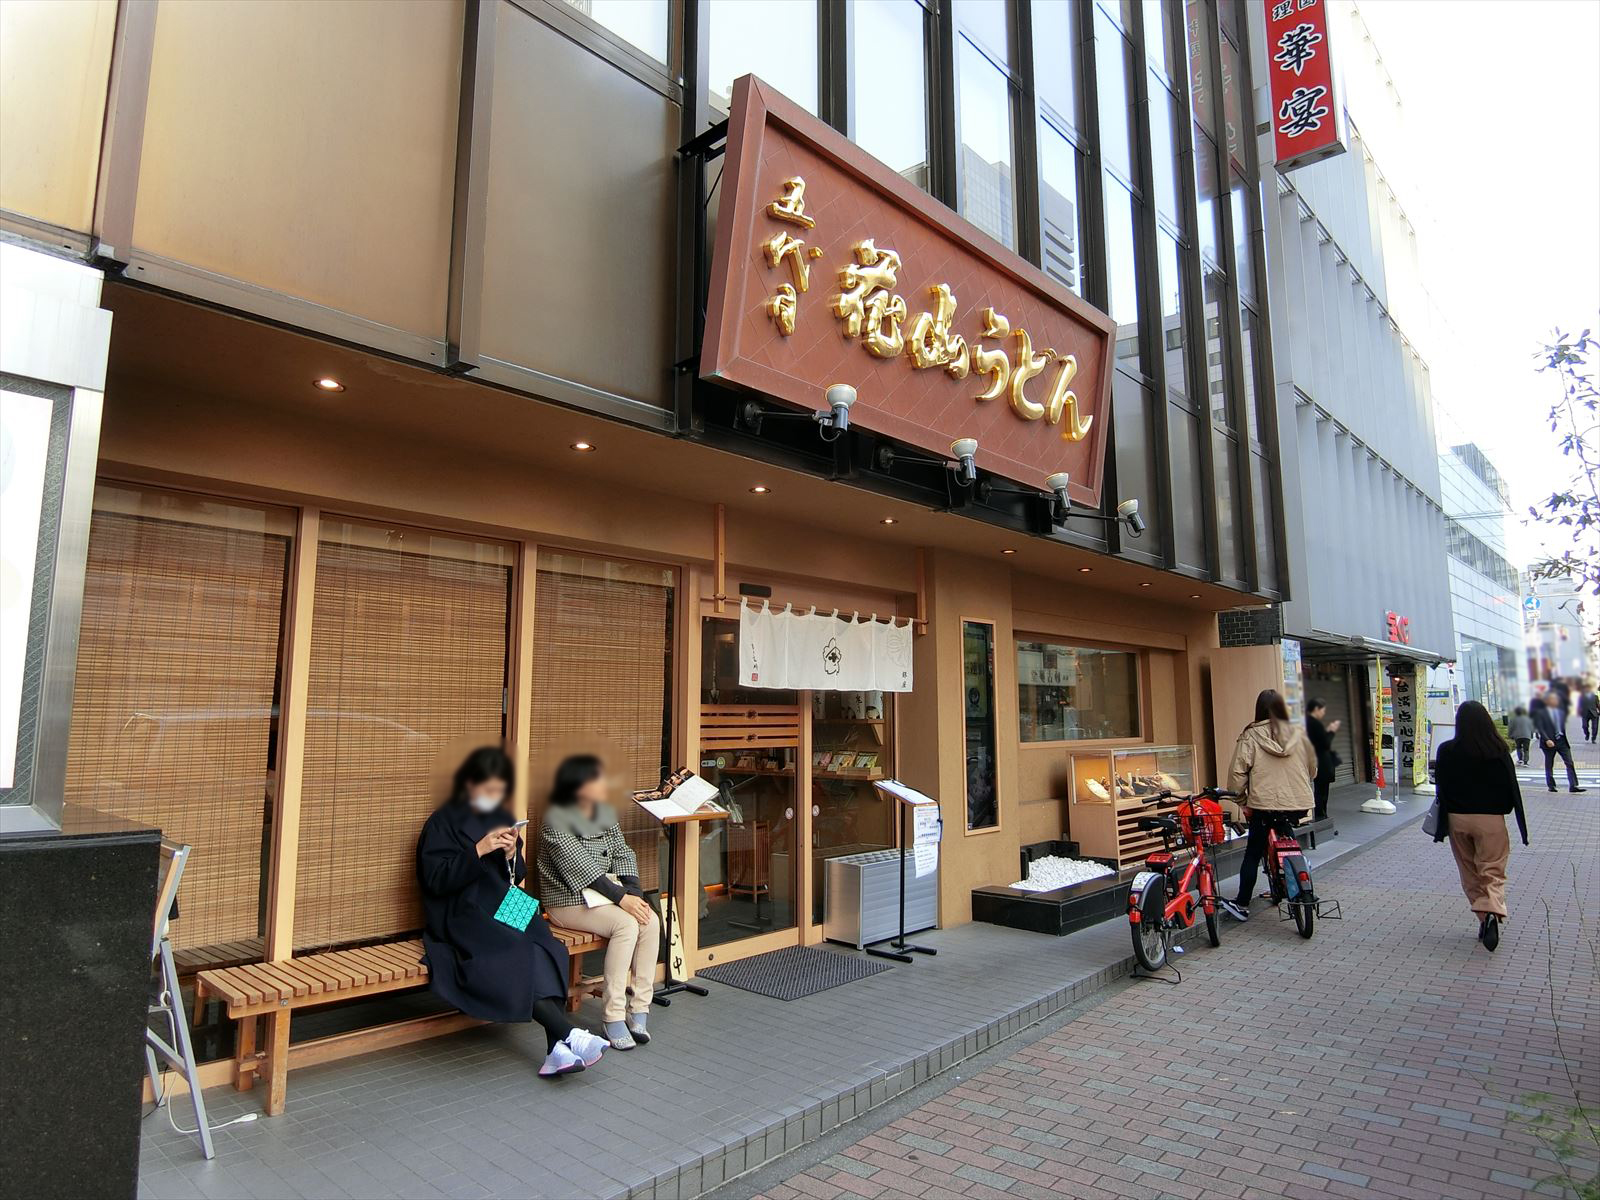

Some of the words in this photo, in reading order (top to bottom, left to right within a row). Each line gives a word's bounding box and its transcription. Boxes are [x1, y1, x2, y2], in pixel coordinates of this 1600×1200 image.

[1274, 23, 1328, 138] 華宴
[830, 237, 1094, 443] 花山うどん
